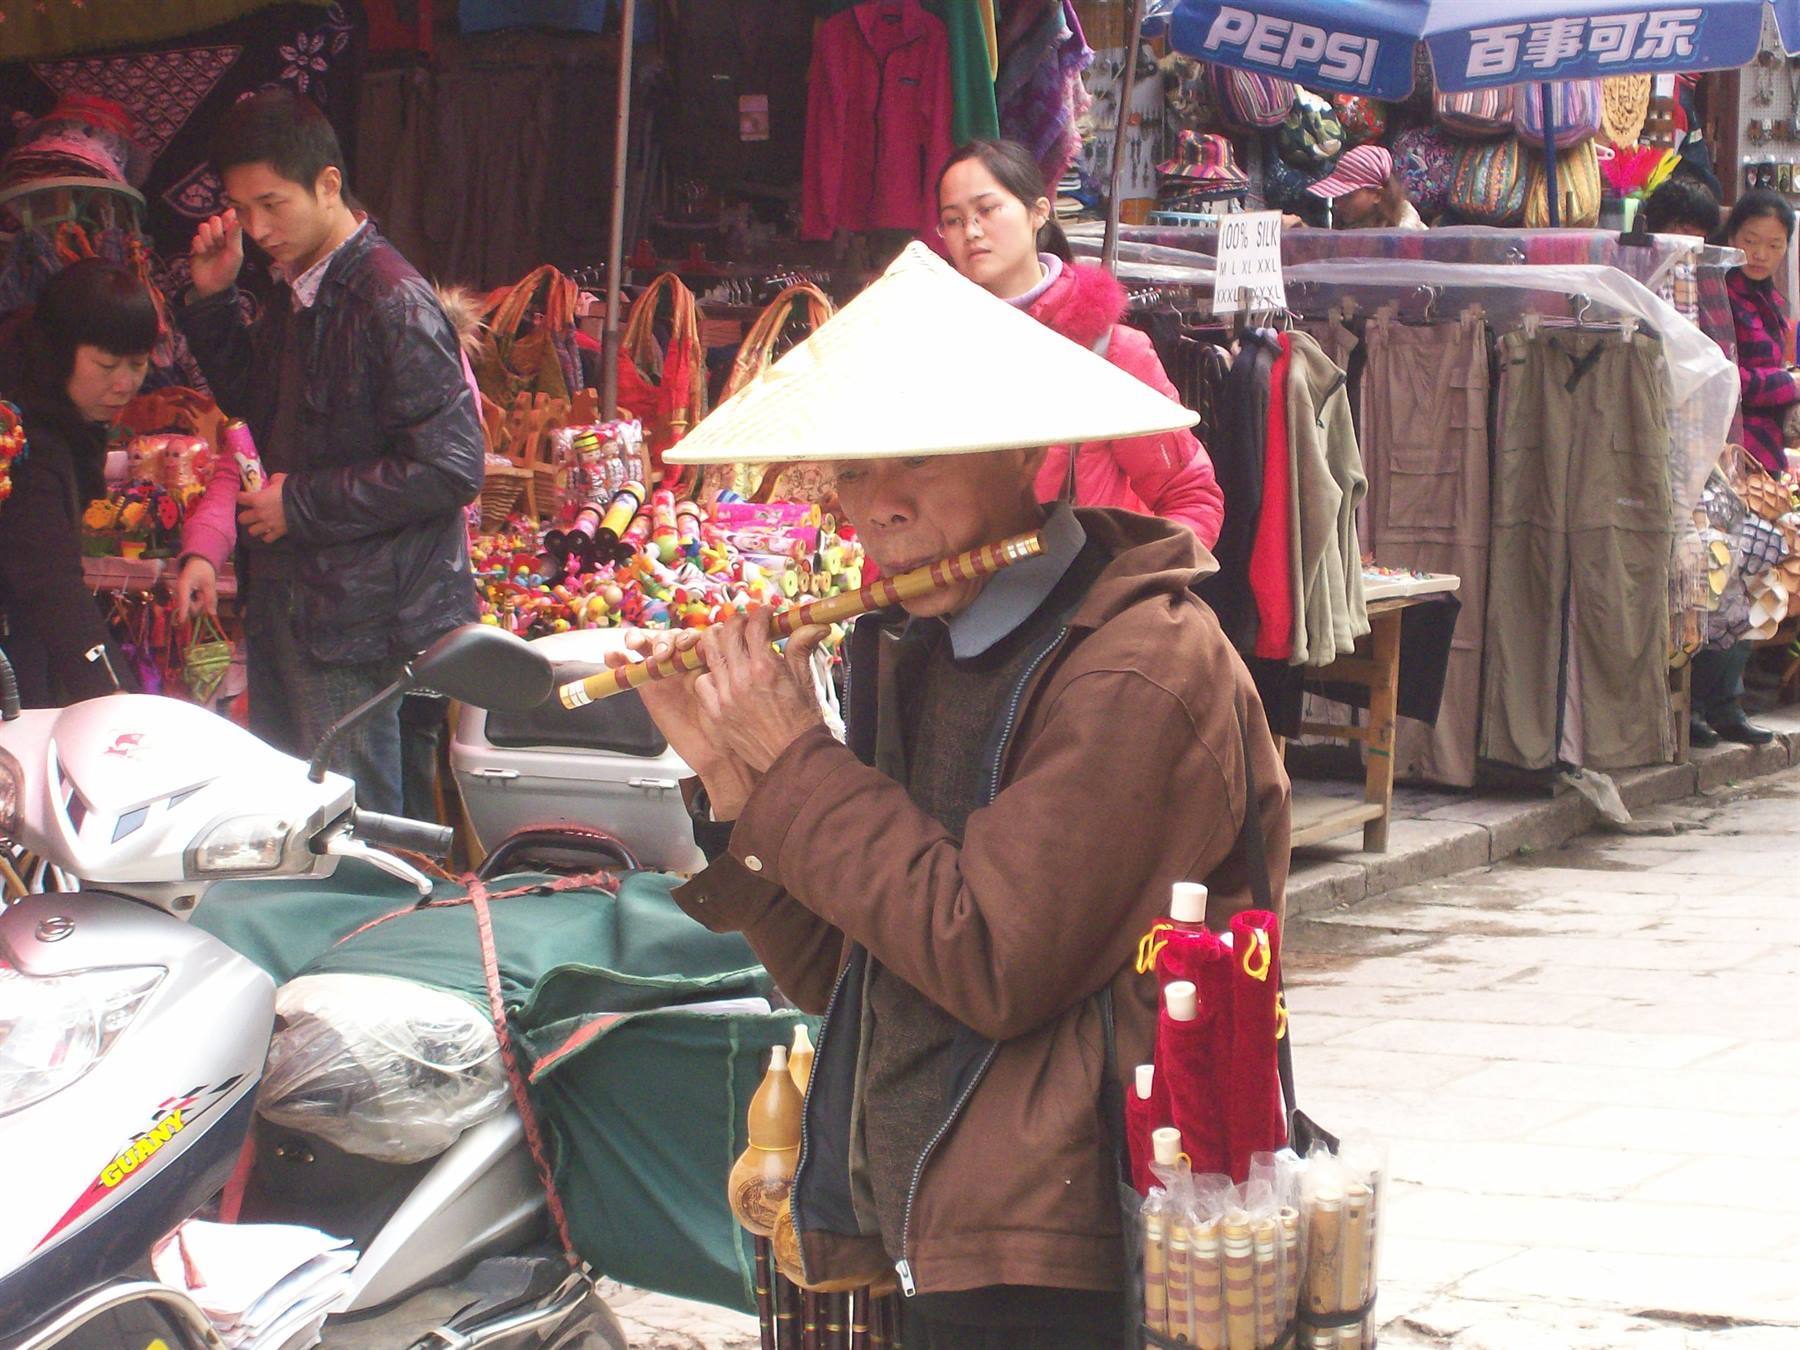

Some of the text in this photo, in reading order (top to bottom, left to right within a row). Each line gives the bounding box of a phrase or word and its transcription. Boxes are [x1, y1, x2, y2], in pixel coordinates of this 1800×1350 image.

[1203, 6, 1380, 85] PEPSI
[1465, 8, 1702, 77] 百事可乐
[1221, 219, 1280, 250] 100% SILK
[1220, 258, 1278, 276] M L XL XXL
[1216, 287, 1238, 304] XXXL
[100, 1108, 184, 1188] GUANY
